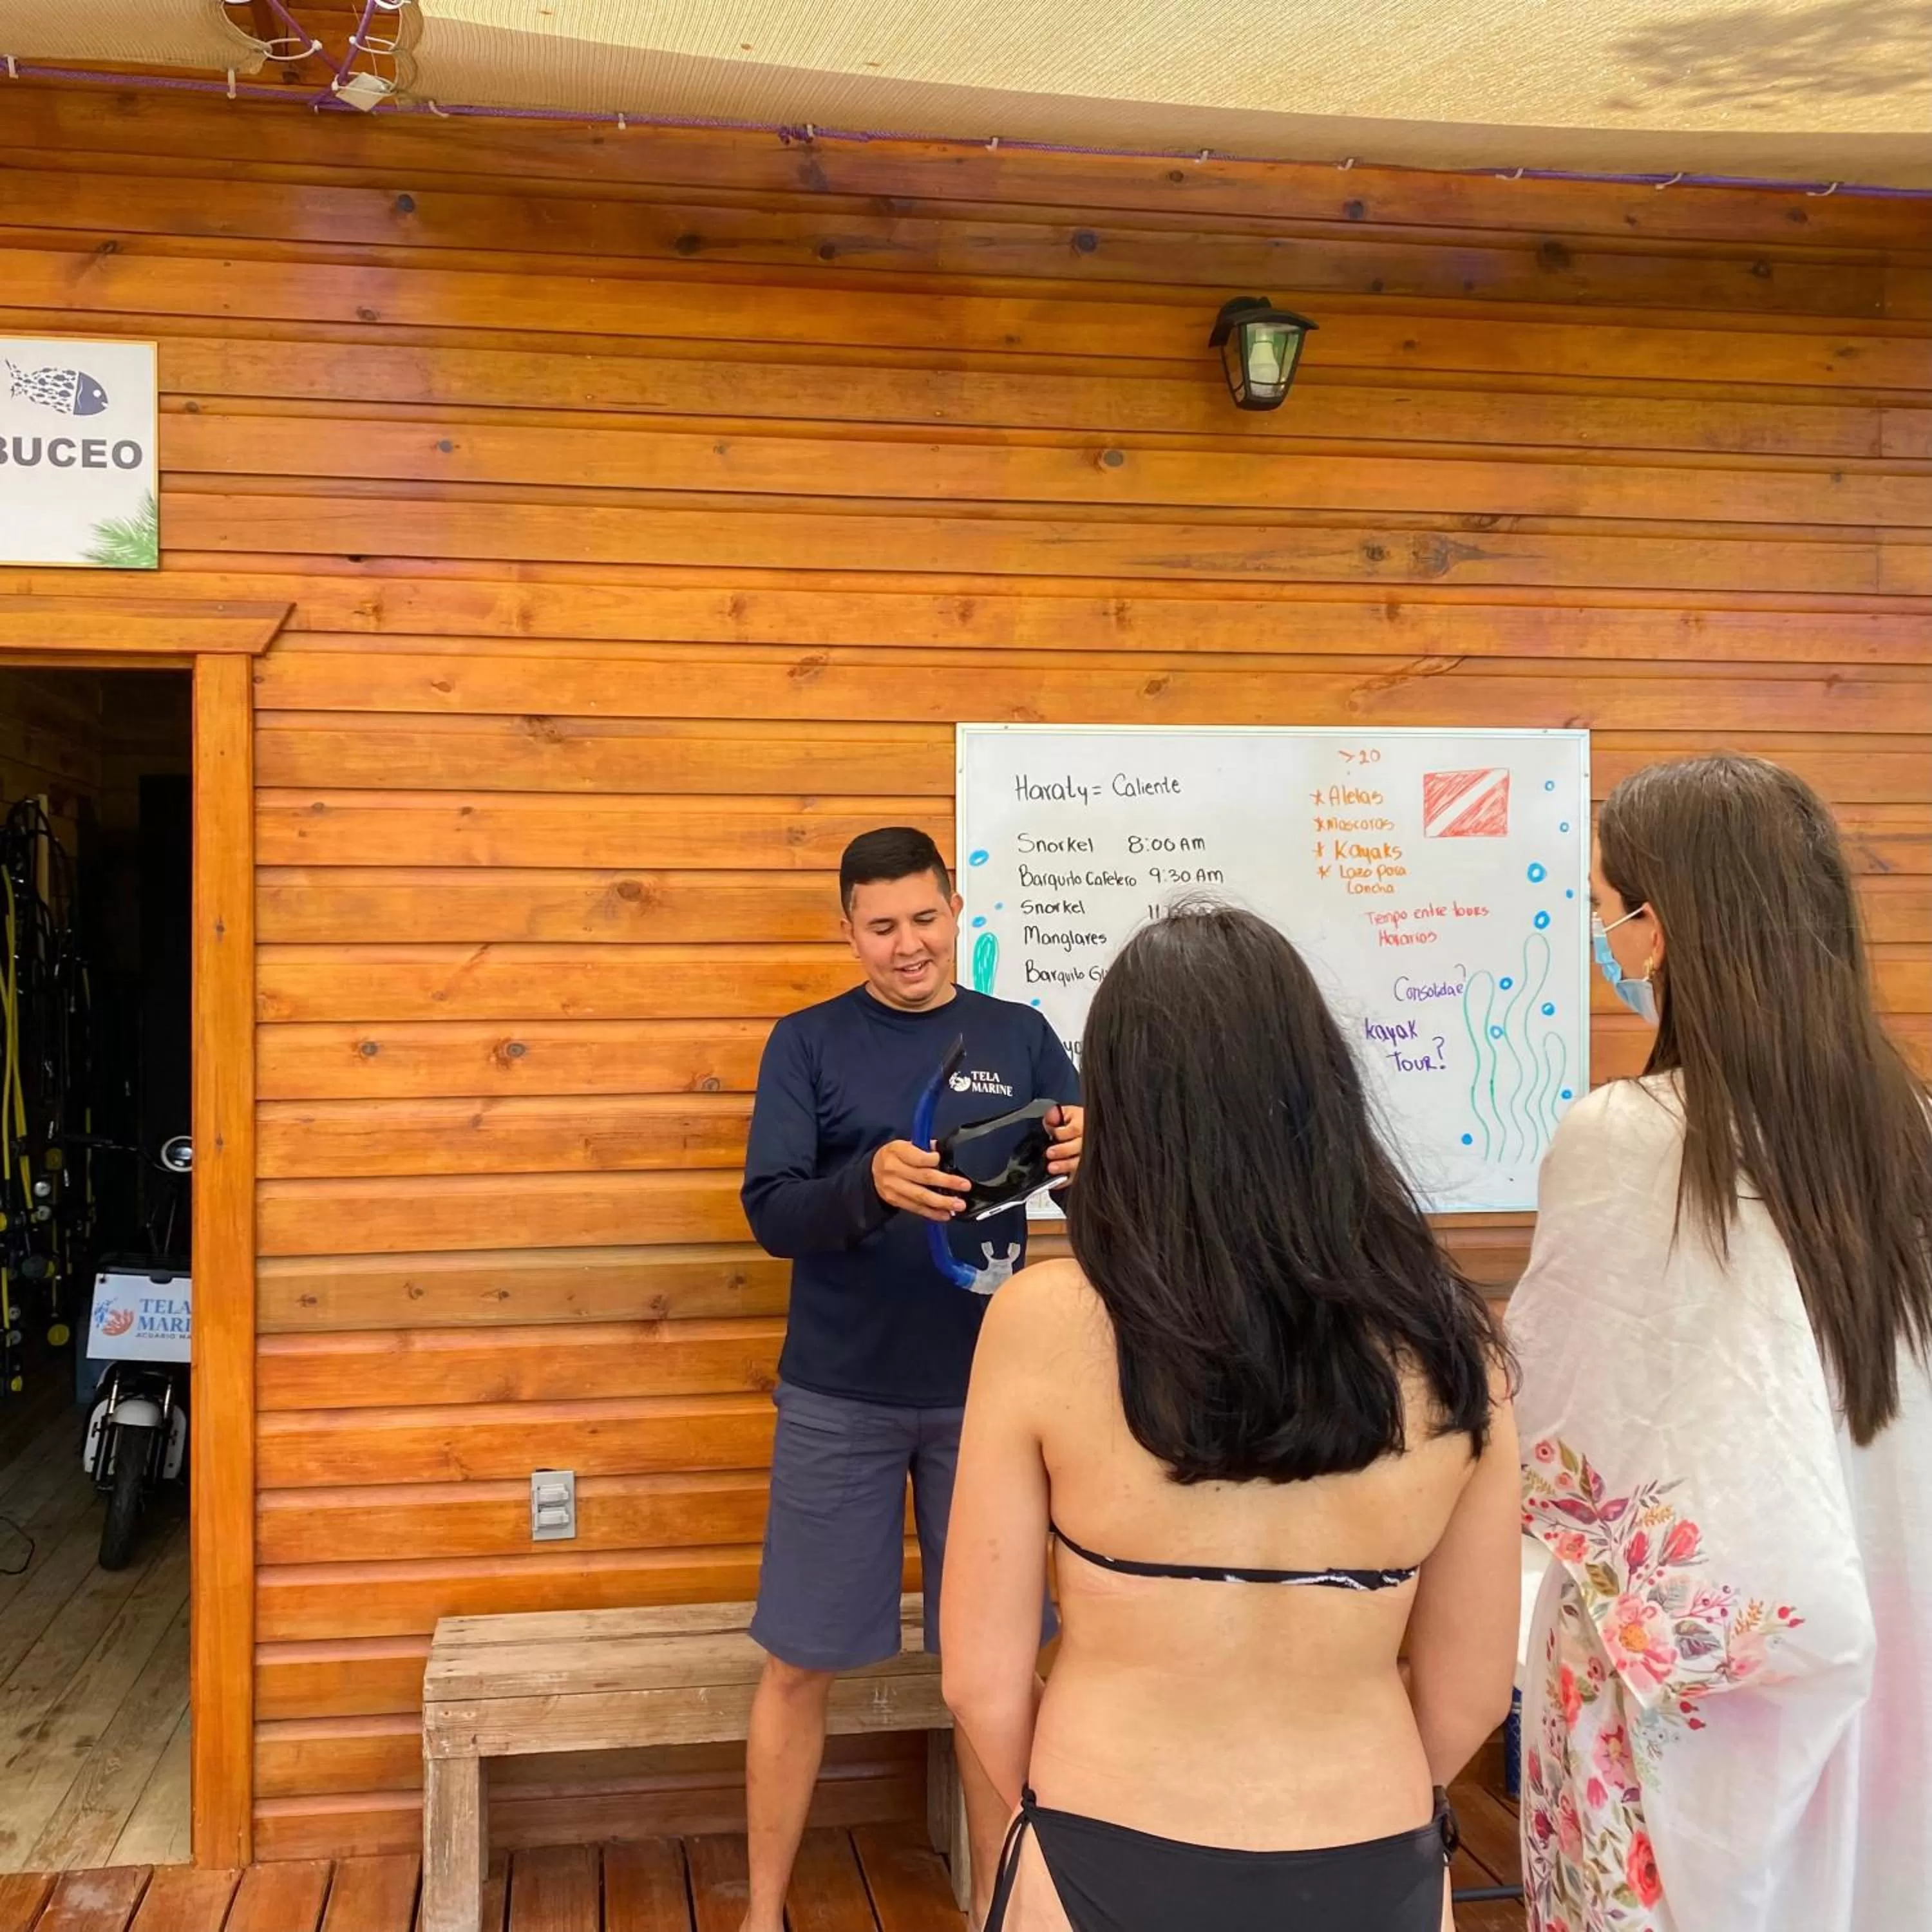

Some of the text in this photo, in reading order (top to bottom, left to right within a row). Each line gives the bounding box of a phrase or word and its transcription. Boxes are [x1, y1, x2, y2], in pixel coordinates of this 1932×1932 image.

[1113, 773, 1182, 797] Caliente
[1329, 784, 1383, 806] Aletas
[1018, 833, 1094, 853] Snorkel
[1128, 835, 1175, 853] 8:00
[1335, 840, 1403, 864] Kayaks
[1149, 867, 1191, 884] 9:30
[1020, 900, 1085, 914] Snorkel
[1025, 925, 1107, 952] Manglares
[971, 1071, 1000, 1083] TELA
[972, 1081, 1013, 1097] MARINE
[139, 1298, 191, 1314] TELA
[137, 1316, 191, 1332] MARI
